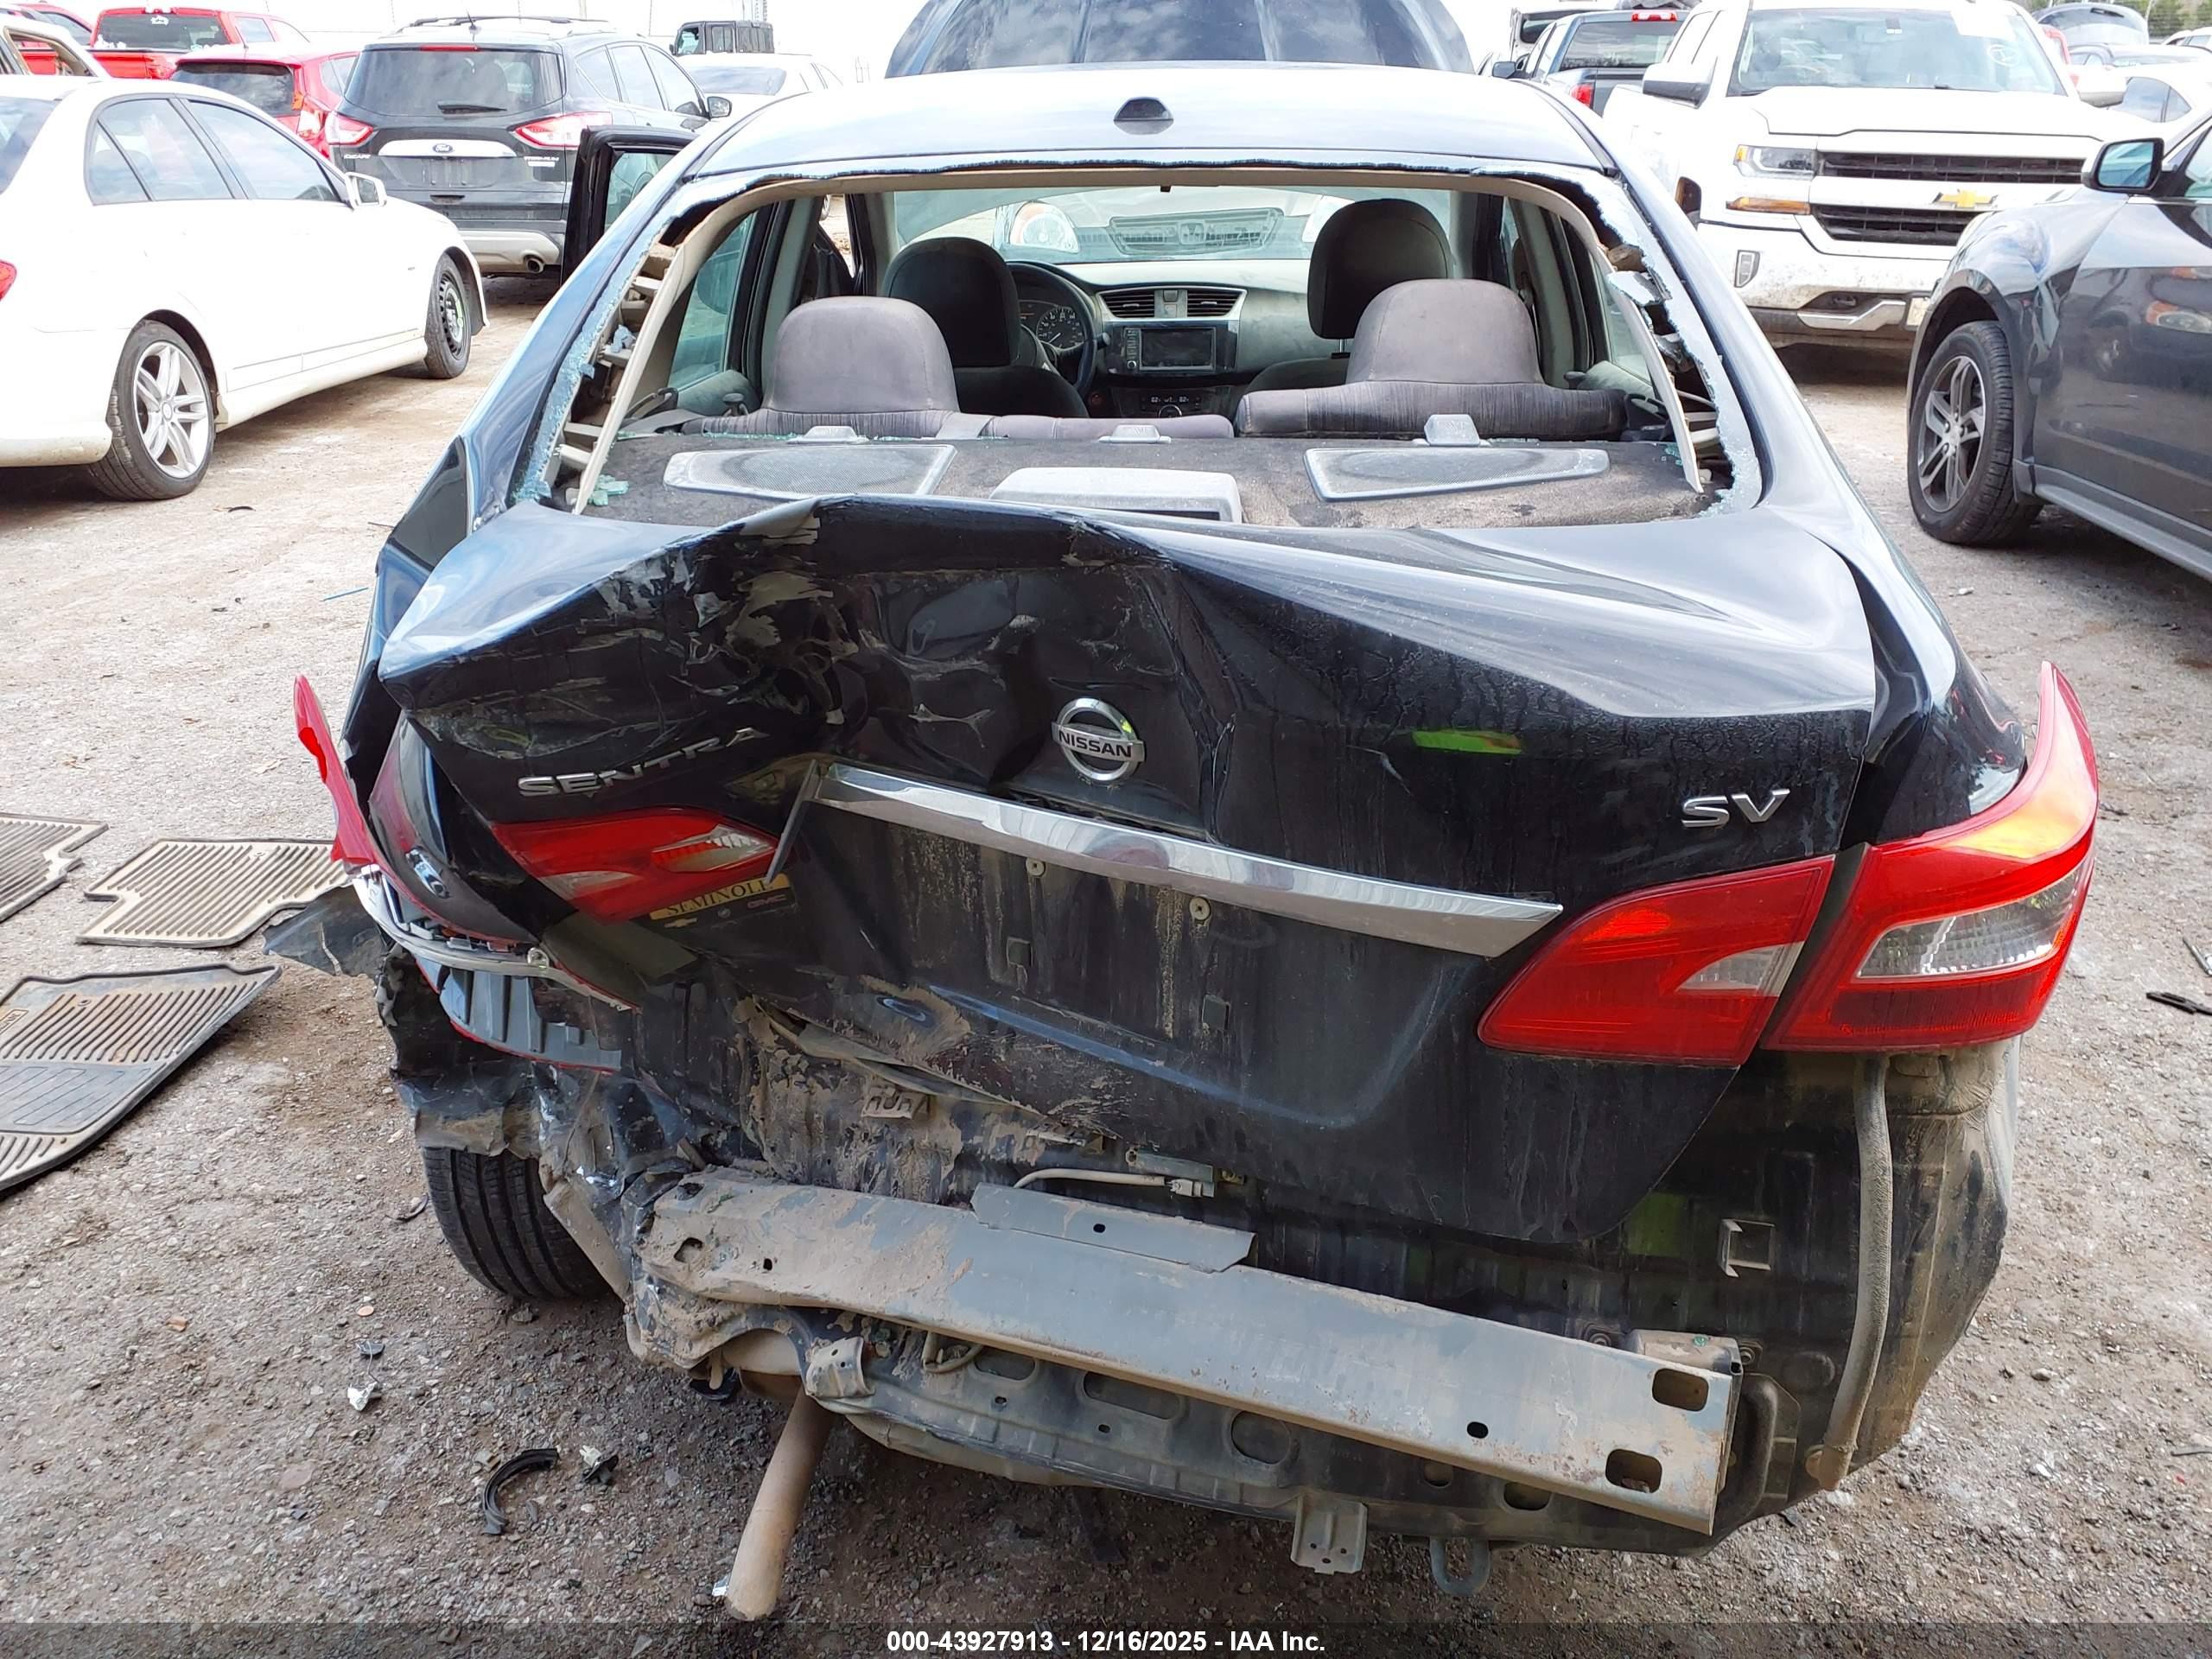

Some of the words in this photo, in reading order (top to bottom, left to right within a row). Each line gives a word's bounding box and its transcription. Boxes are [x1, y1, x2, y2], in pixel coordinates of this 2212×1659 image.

[518, 728, 769, 797] SENTRA
[1058, 729, 1132, 758] NISSAN
[1681, 788, 1791, 830] SV
